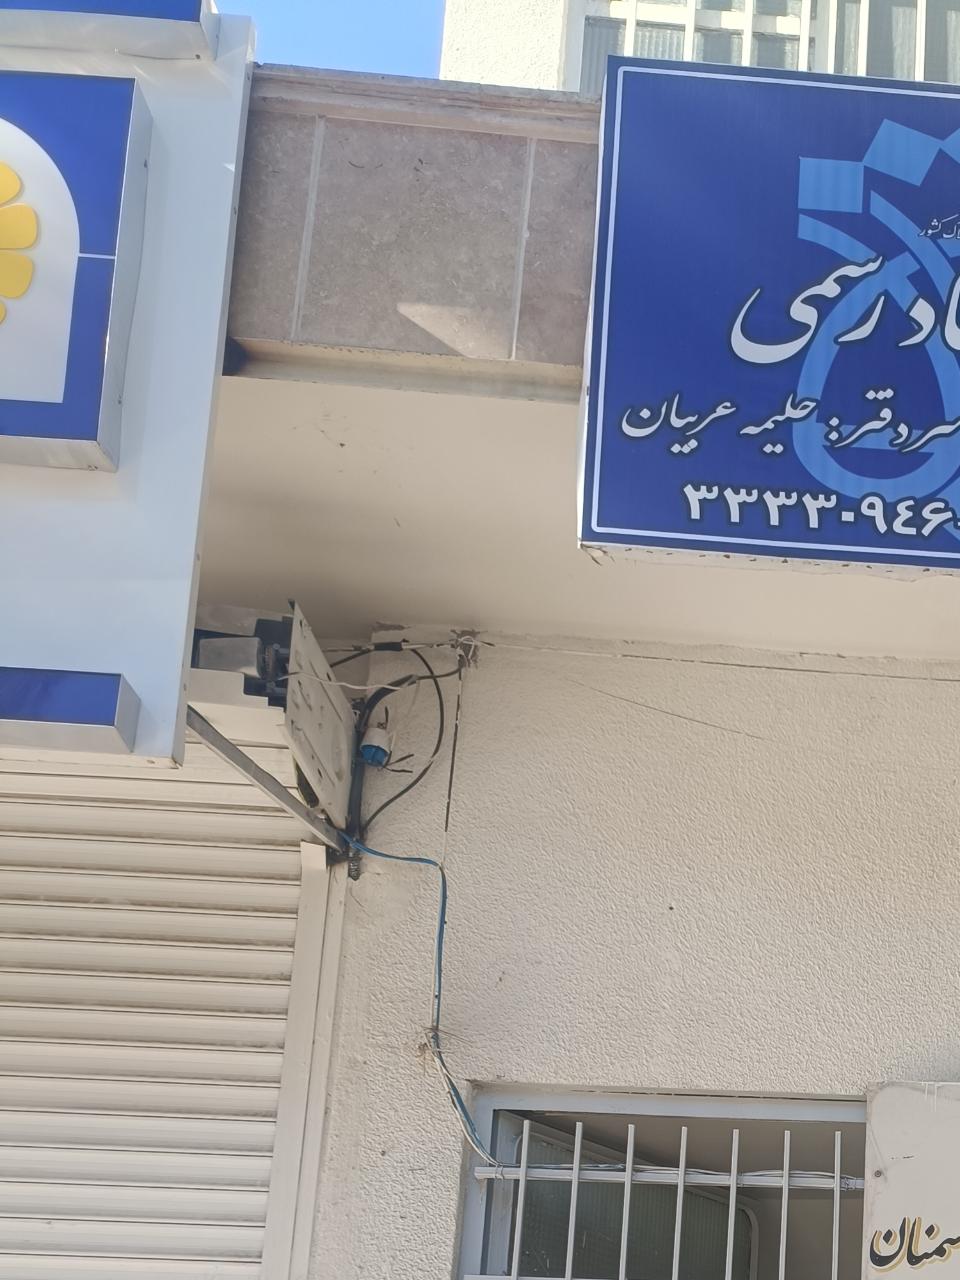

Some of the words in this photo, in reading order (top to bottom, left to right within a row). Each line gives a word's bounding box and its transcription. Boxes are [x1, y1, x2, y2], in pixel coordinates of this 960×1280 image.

[919, 214, 959, 237] کشور
[730, 255, 885, 364] رسمی
[621, 393, 737, 454] عربیان
[740, 393, 817, 454] حلیمه
